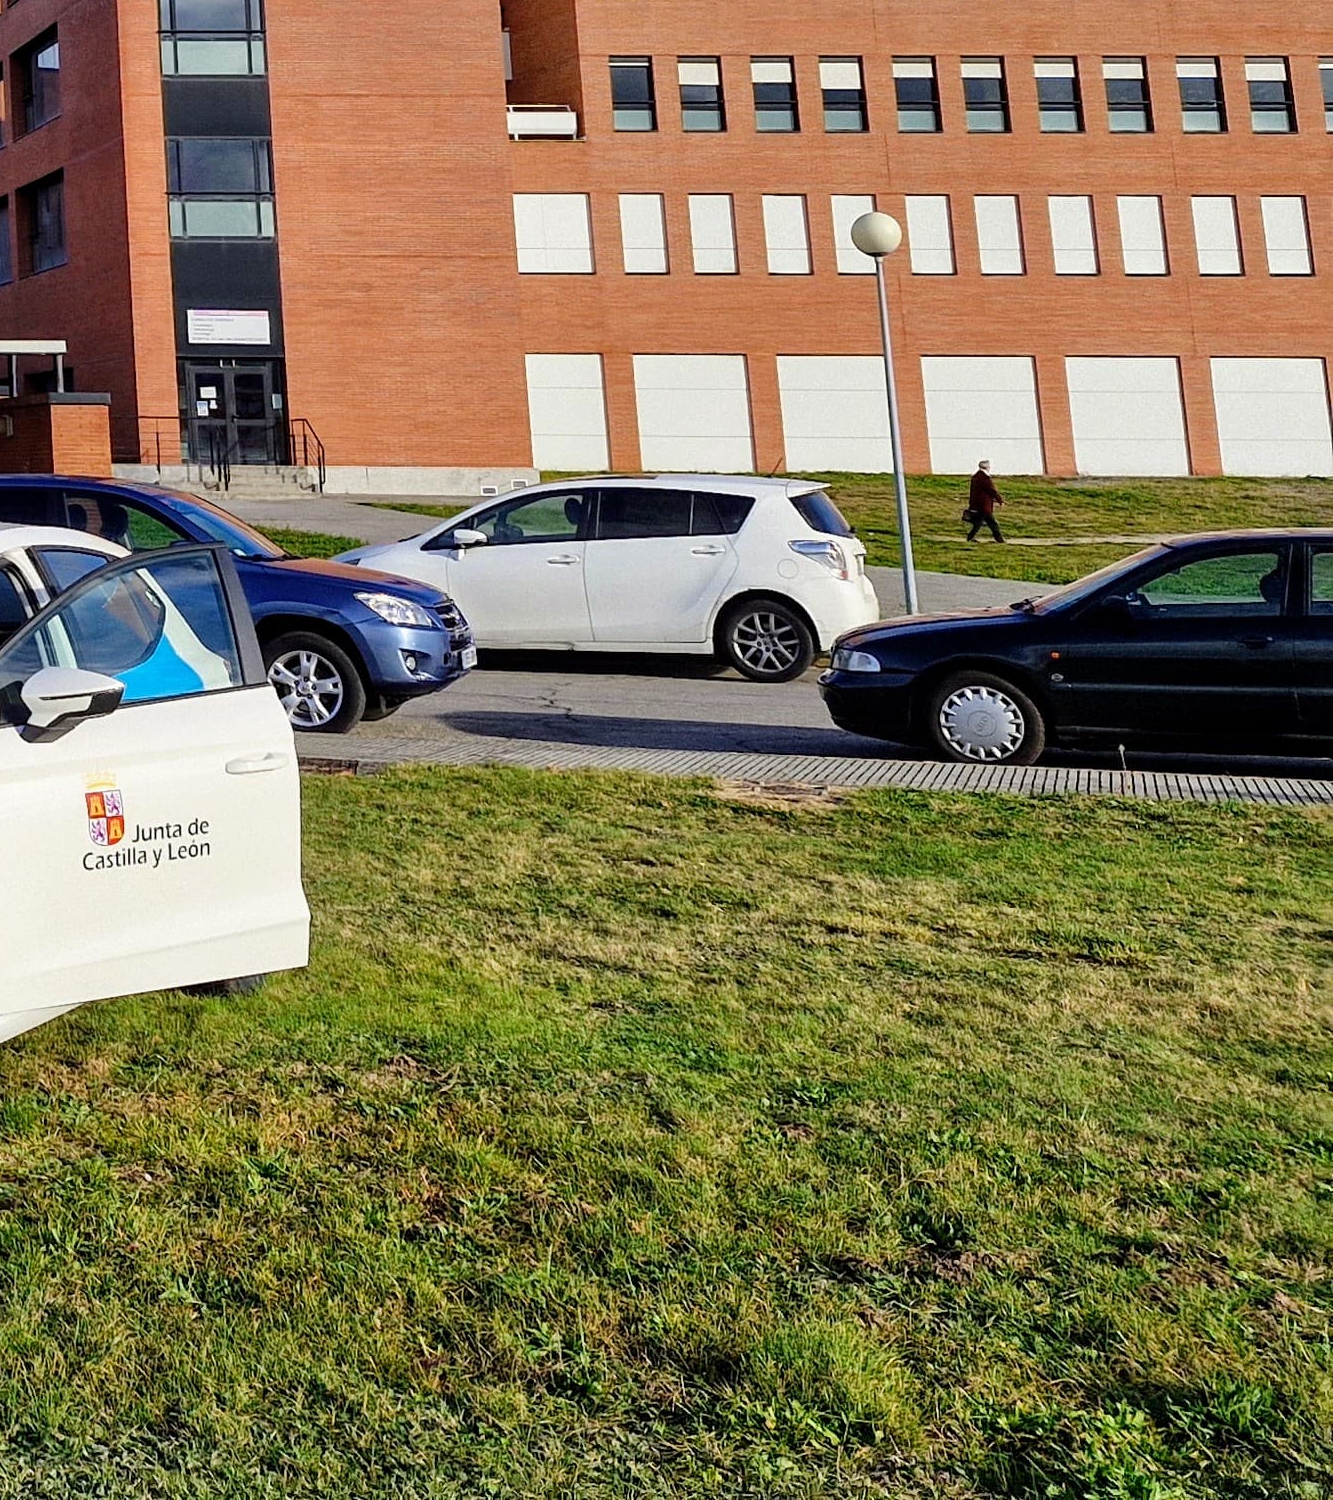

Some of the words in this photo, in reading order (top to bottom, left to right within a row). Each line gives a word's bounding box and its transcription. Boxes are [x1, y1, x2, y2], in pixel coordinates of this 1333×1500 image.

[132, 822, 182, 843] Junta
[188, 818, 210, 836] de
[83, 847, 147, 871] Castilla
[152, 848, 162, 869] y
[168, 839, 211, 861] León
